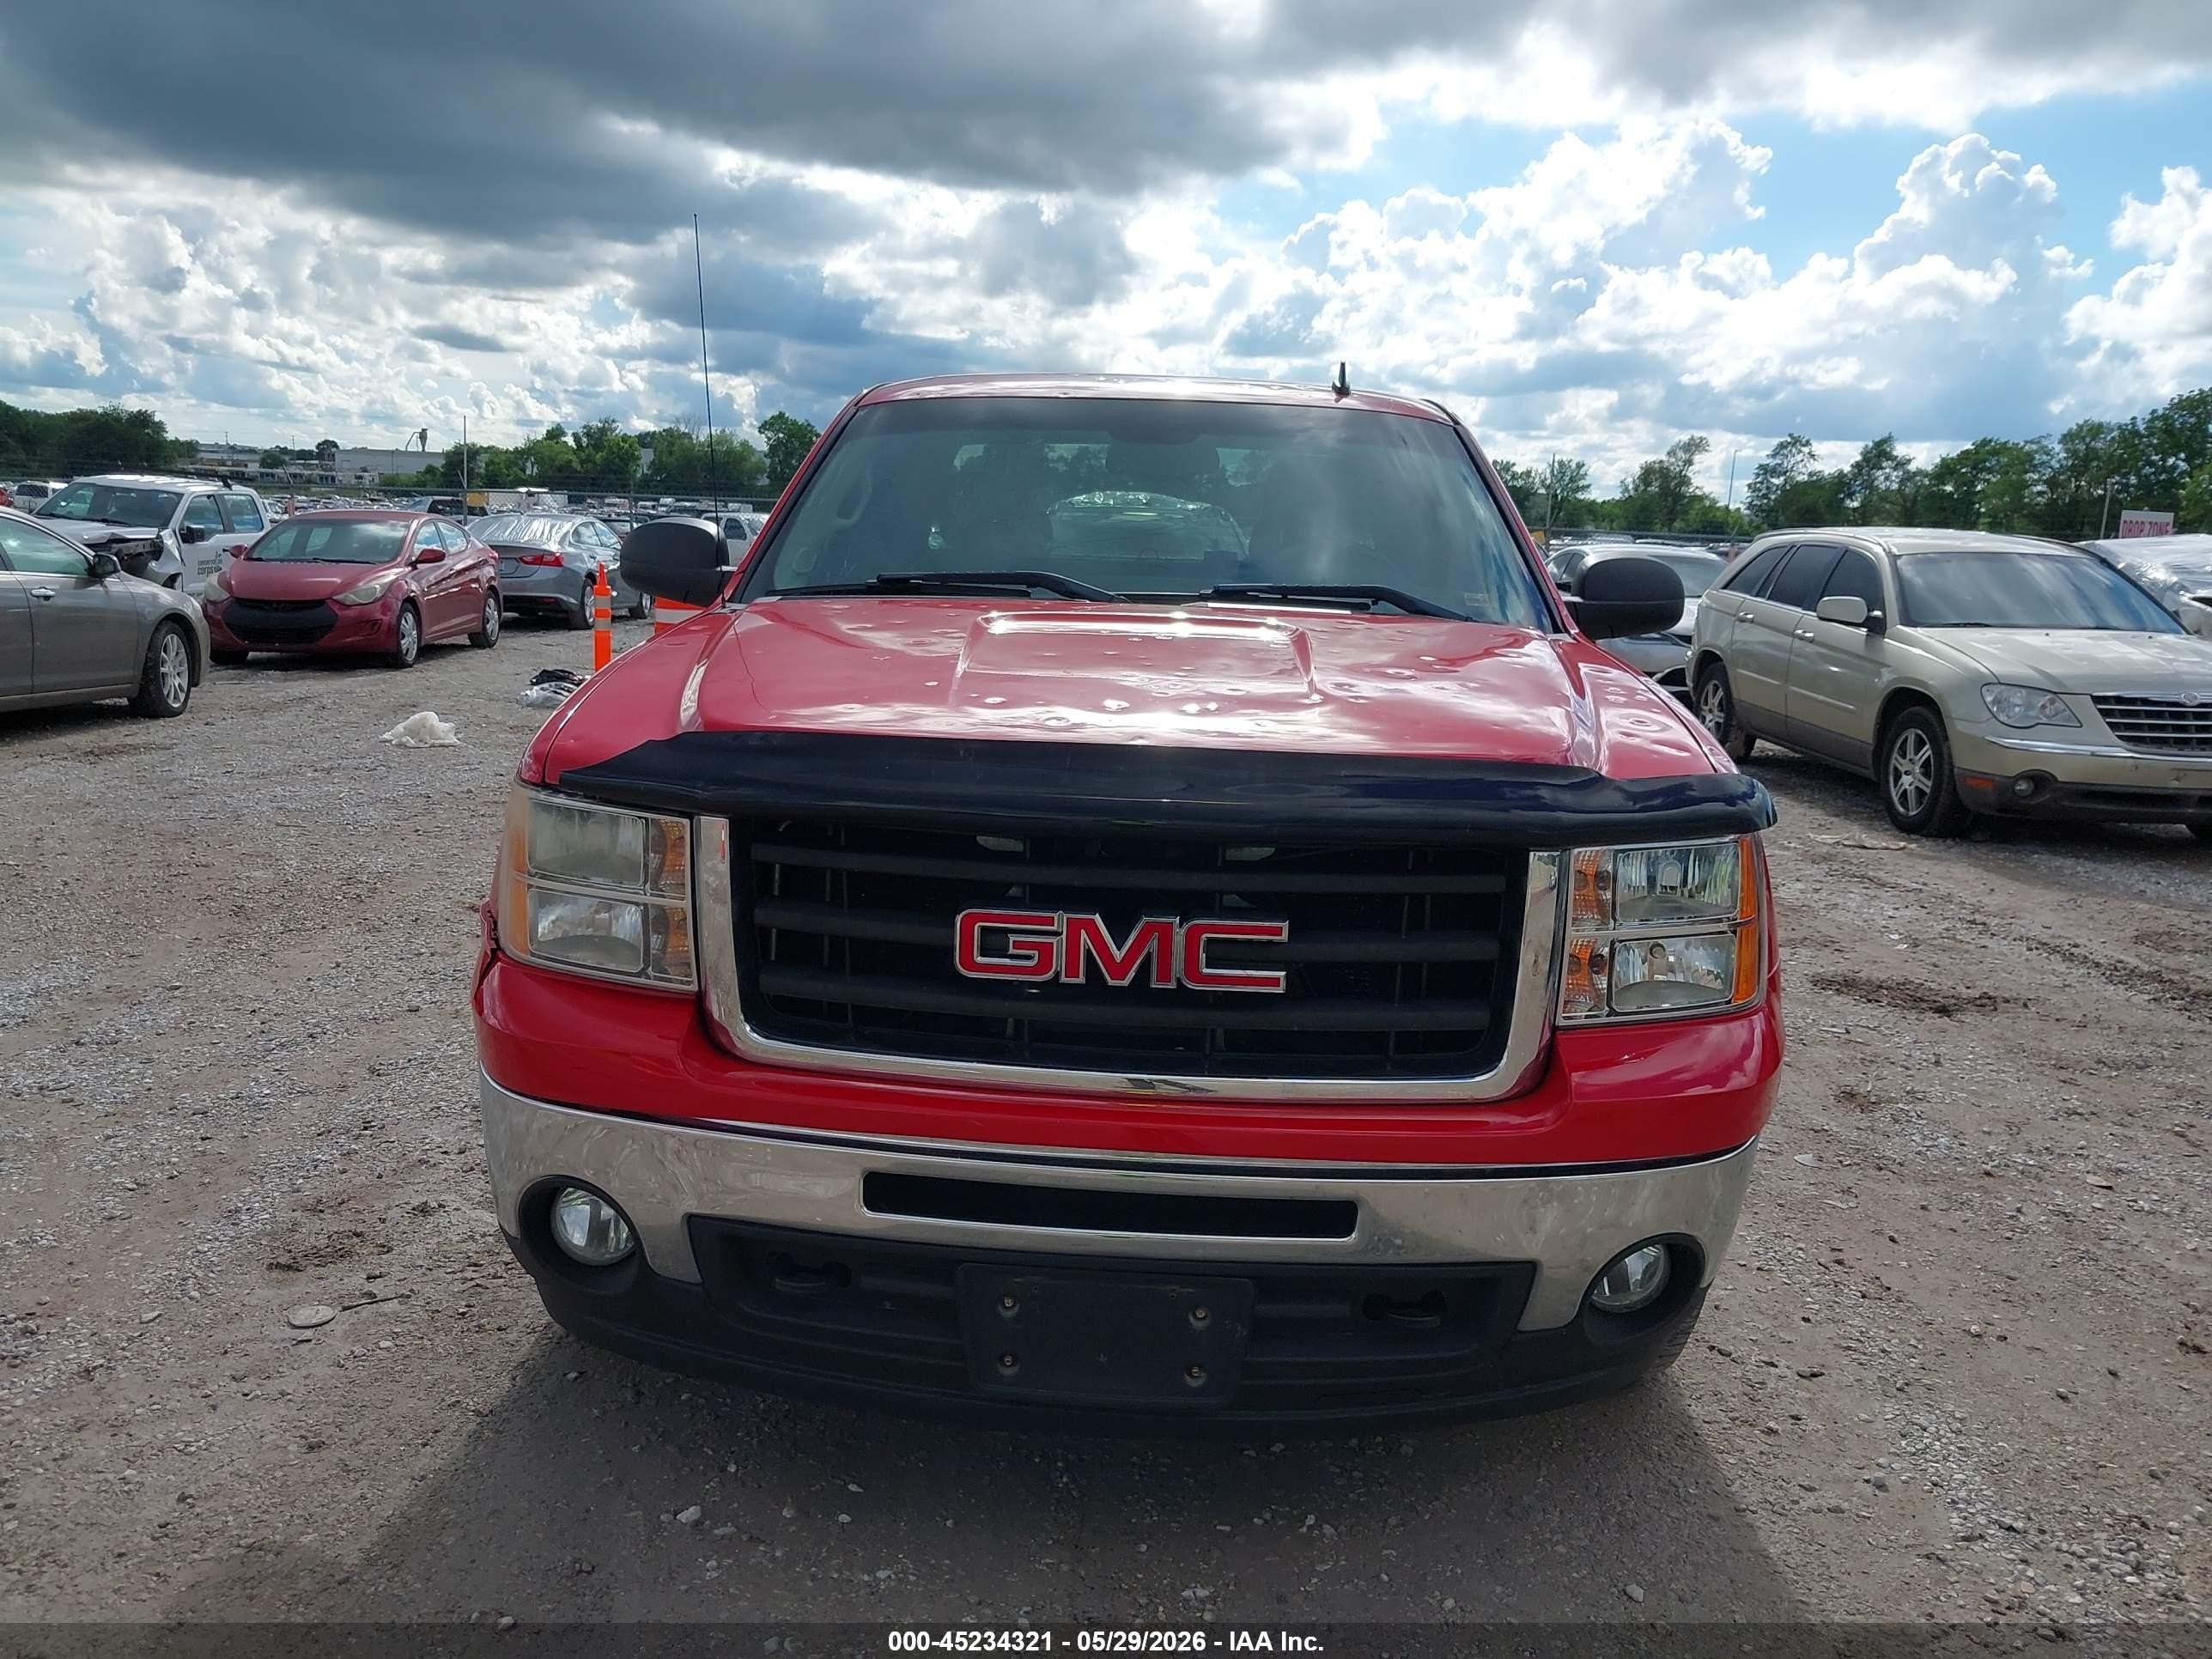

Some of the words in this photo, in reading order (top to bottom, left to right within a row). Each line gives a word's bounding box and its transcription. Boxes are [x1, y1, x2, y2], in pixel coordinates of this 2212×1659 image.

[2122, 520, 2145, 537] DROP
[2147, 521, 2171, 537] ZONE
[954, 909, 1289, 993] GMC
